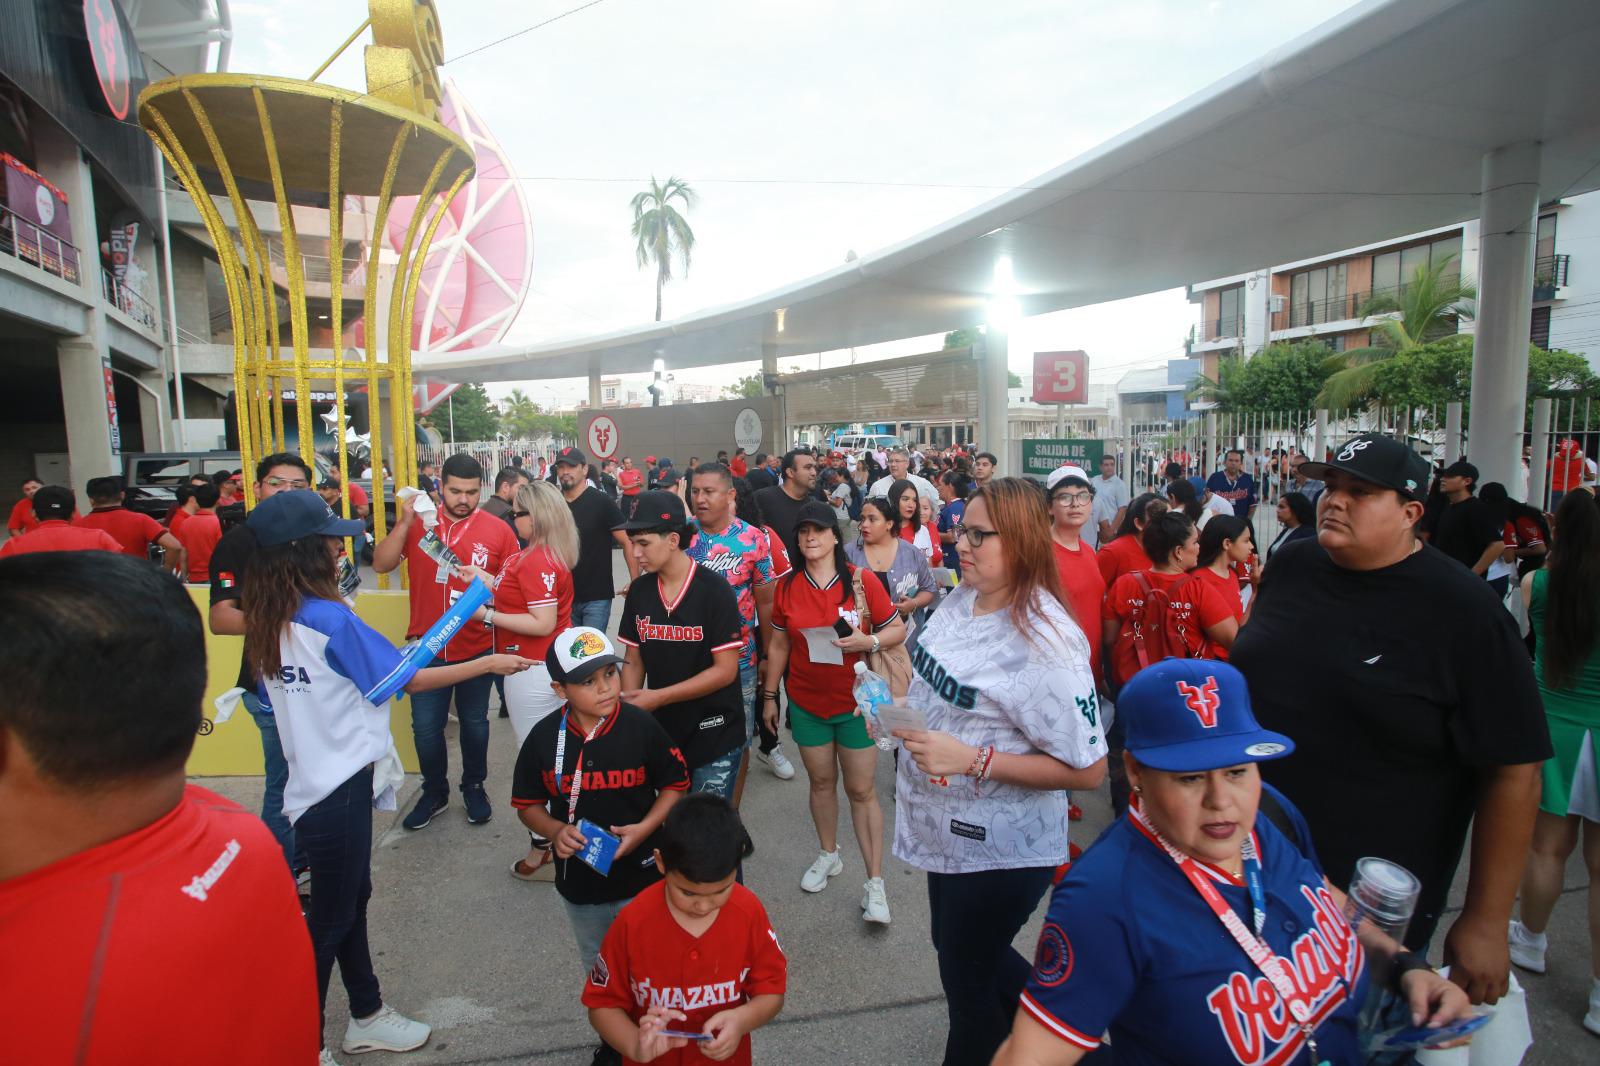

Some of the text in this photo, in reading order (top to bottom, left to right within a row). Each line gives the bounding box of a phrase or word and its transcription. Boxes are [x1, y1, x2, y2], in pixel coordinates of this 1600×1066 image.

[1053, 360, 1077, 392] 3
[1035, 444, 1085, 456] SALIDA DE
[437, 615, 461, 643] HERSA
[650, 978, 742, 1010] MAZATL
